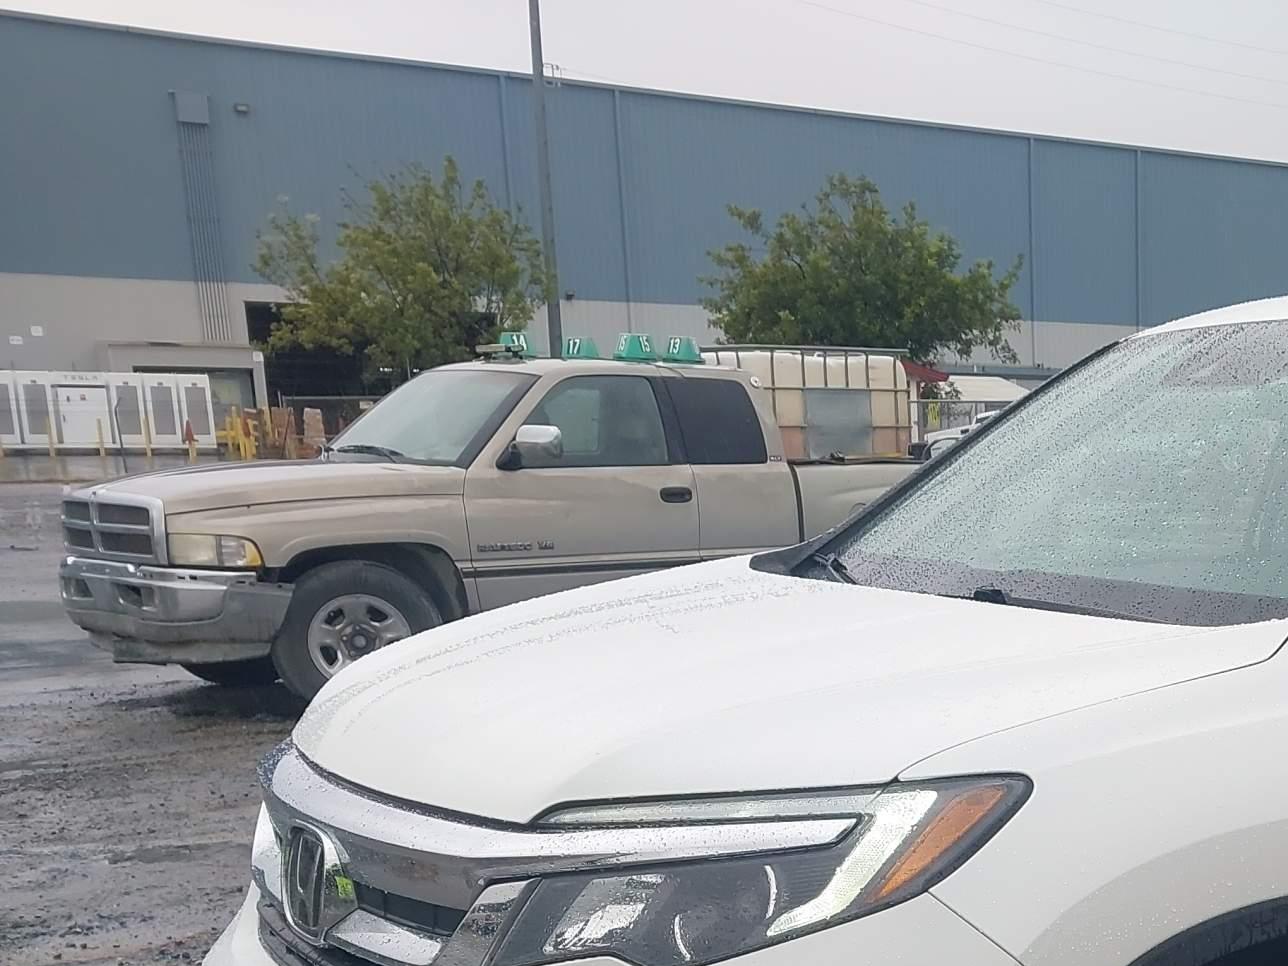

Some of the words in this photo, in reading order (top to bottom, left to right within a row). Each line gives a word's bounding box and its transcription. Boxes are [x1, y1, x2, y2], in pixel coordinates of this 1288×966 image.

[512, 333, 527, 351] 14
[568, 338, 580, 355] 17
[639, 335, 651, 352] 15
[669, 338, 681, 354] 13
